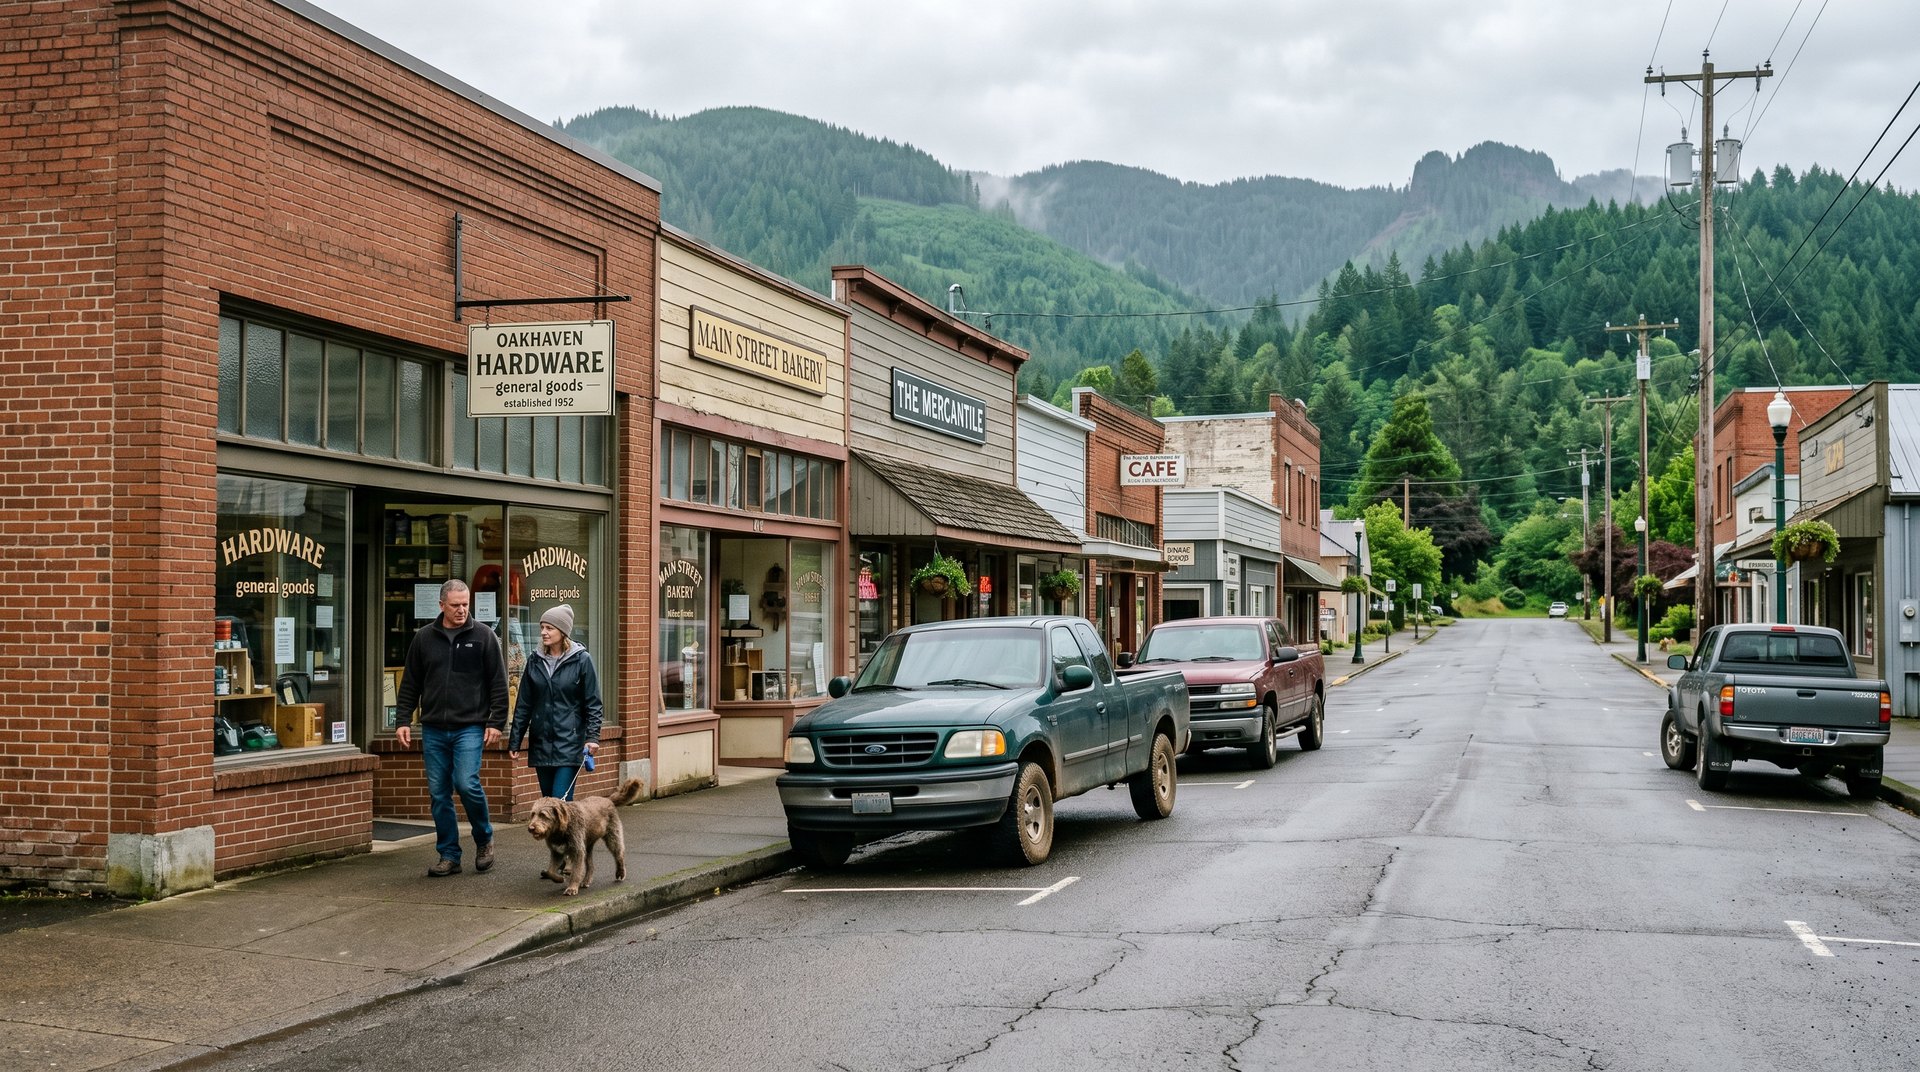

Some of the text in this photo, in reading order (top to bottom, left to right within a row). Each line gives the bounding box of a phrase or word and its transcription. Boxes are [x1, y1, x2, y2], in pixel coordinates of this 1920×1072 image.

[496, 331, 583, 348] OAKHAVEN
[476, 351, 605, 375] HARDWARE
[697, 320, 823, 385] MAIN STREET BAKERY
[496, 379, 583, 396] general goods
[504, 398, 574, 408] established 1952
[897, 380, 983, 433] THE MERCANTILE
[1128, 461, 1177, 477] CAFE
[221, 527, 326, 569] HARDWARE
[522, 546, 588, 579] HARDWARE
[658, 559, 703, 588] MAIN STREET
[235, 577, 279, 598] general
[281, 578, 315, 599] goods
[530, 585, 580, 602] general goods
[666, 585, 694, 599] BAKERY
